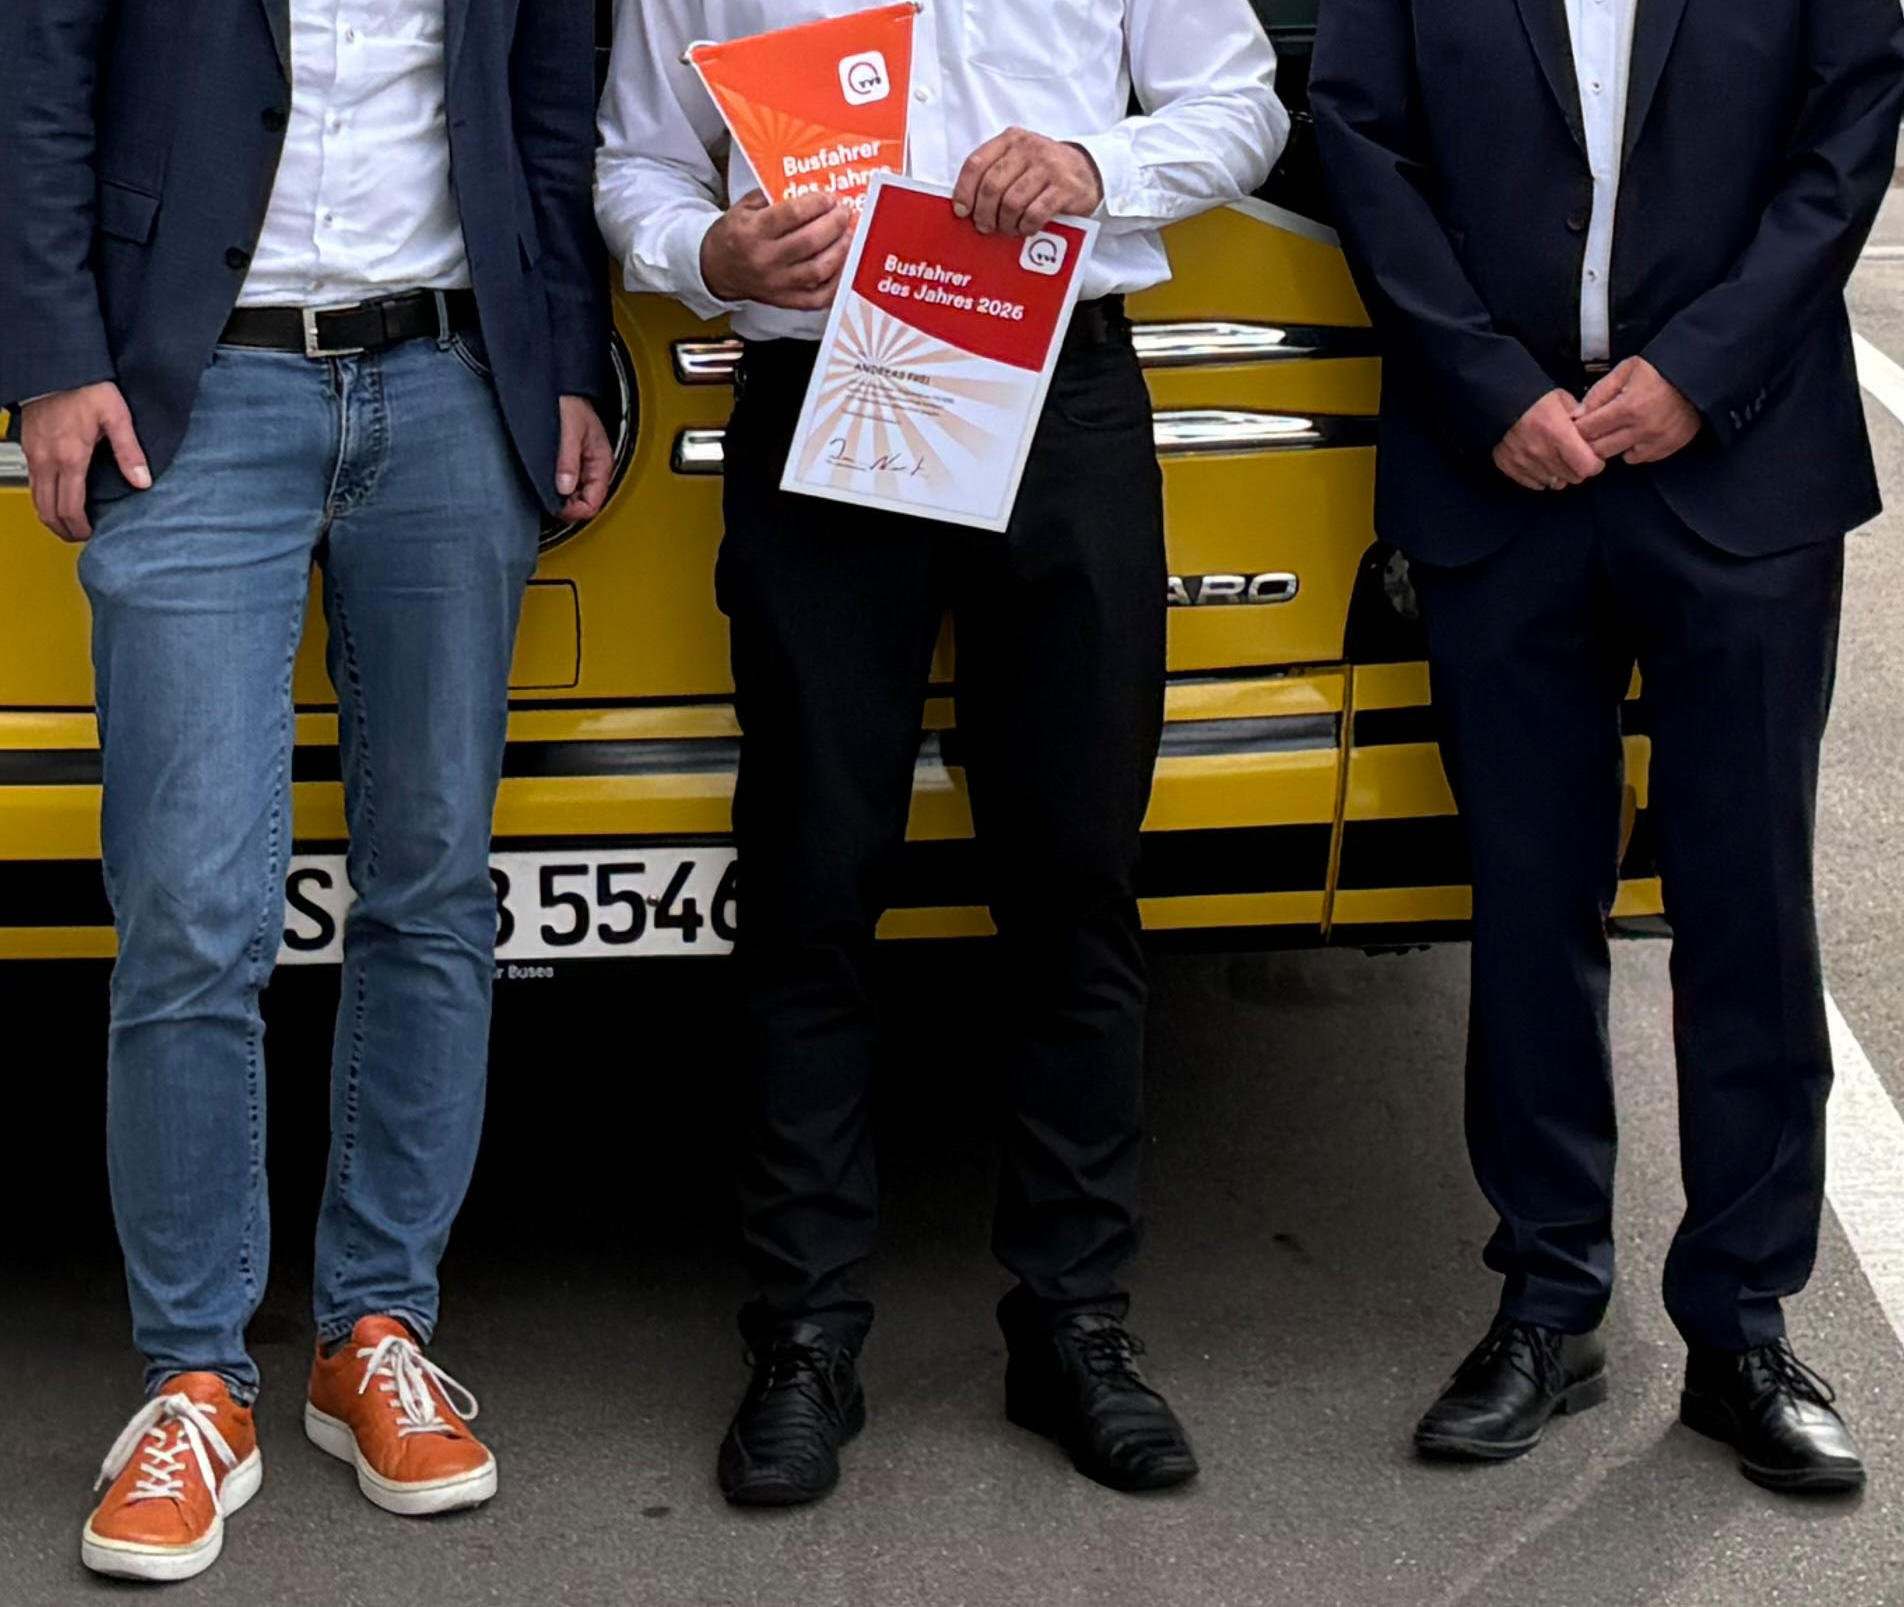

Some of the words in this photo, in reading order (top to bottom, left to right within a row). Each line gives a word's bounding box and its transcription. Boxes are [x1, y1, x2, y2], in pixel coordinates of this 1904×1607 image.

[782, 140, 880, 177] Busfahrer
[884, 254, 972, 287] Busfahrer
[877, 276, 911, 298] des
[913, 284, 974, 310] Jahres
[976, 297, 1025, 321] 2026
[1166, 571, 1299, 605] ARO
[283, 867, 336, 951] S
